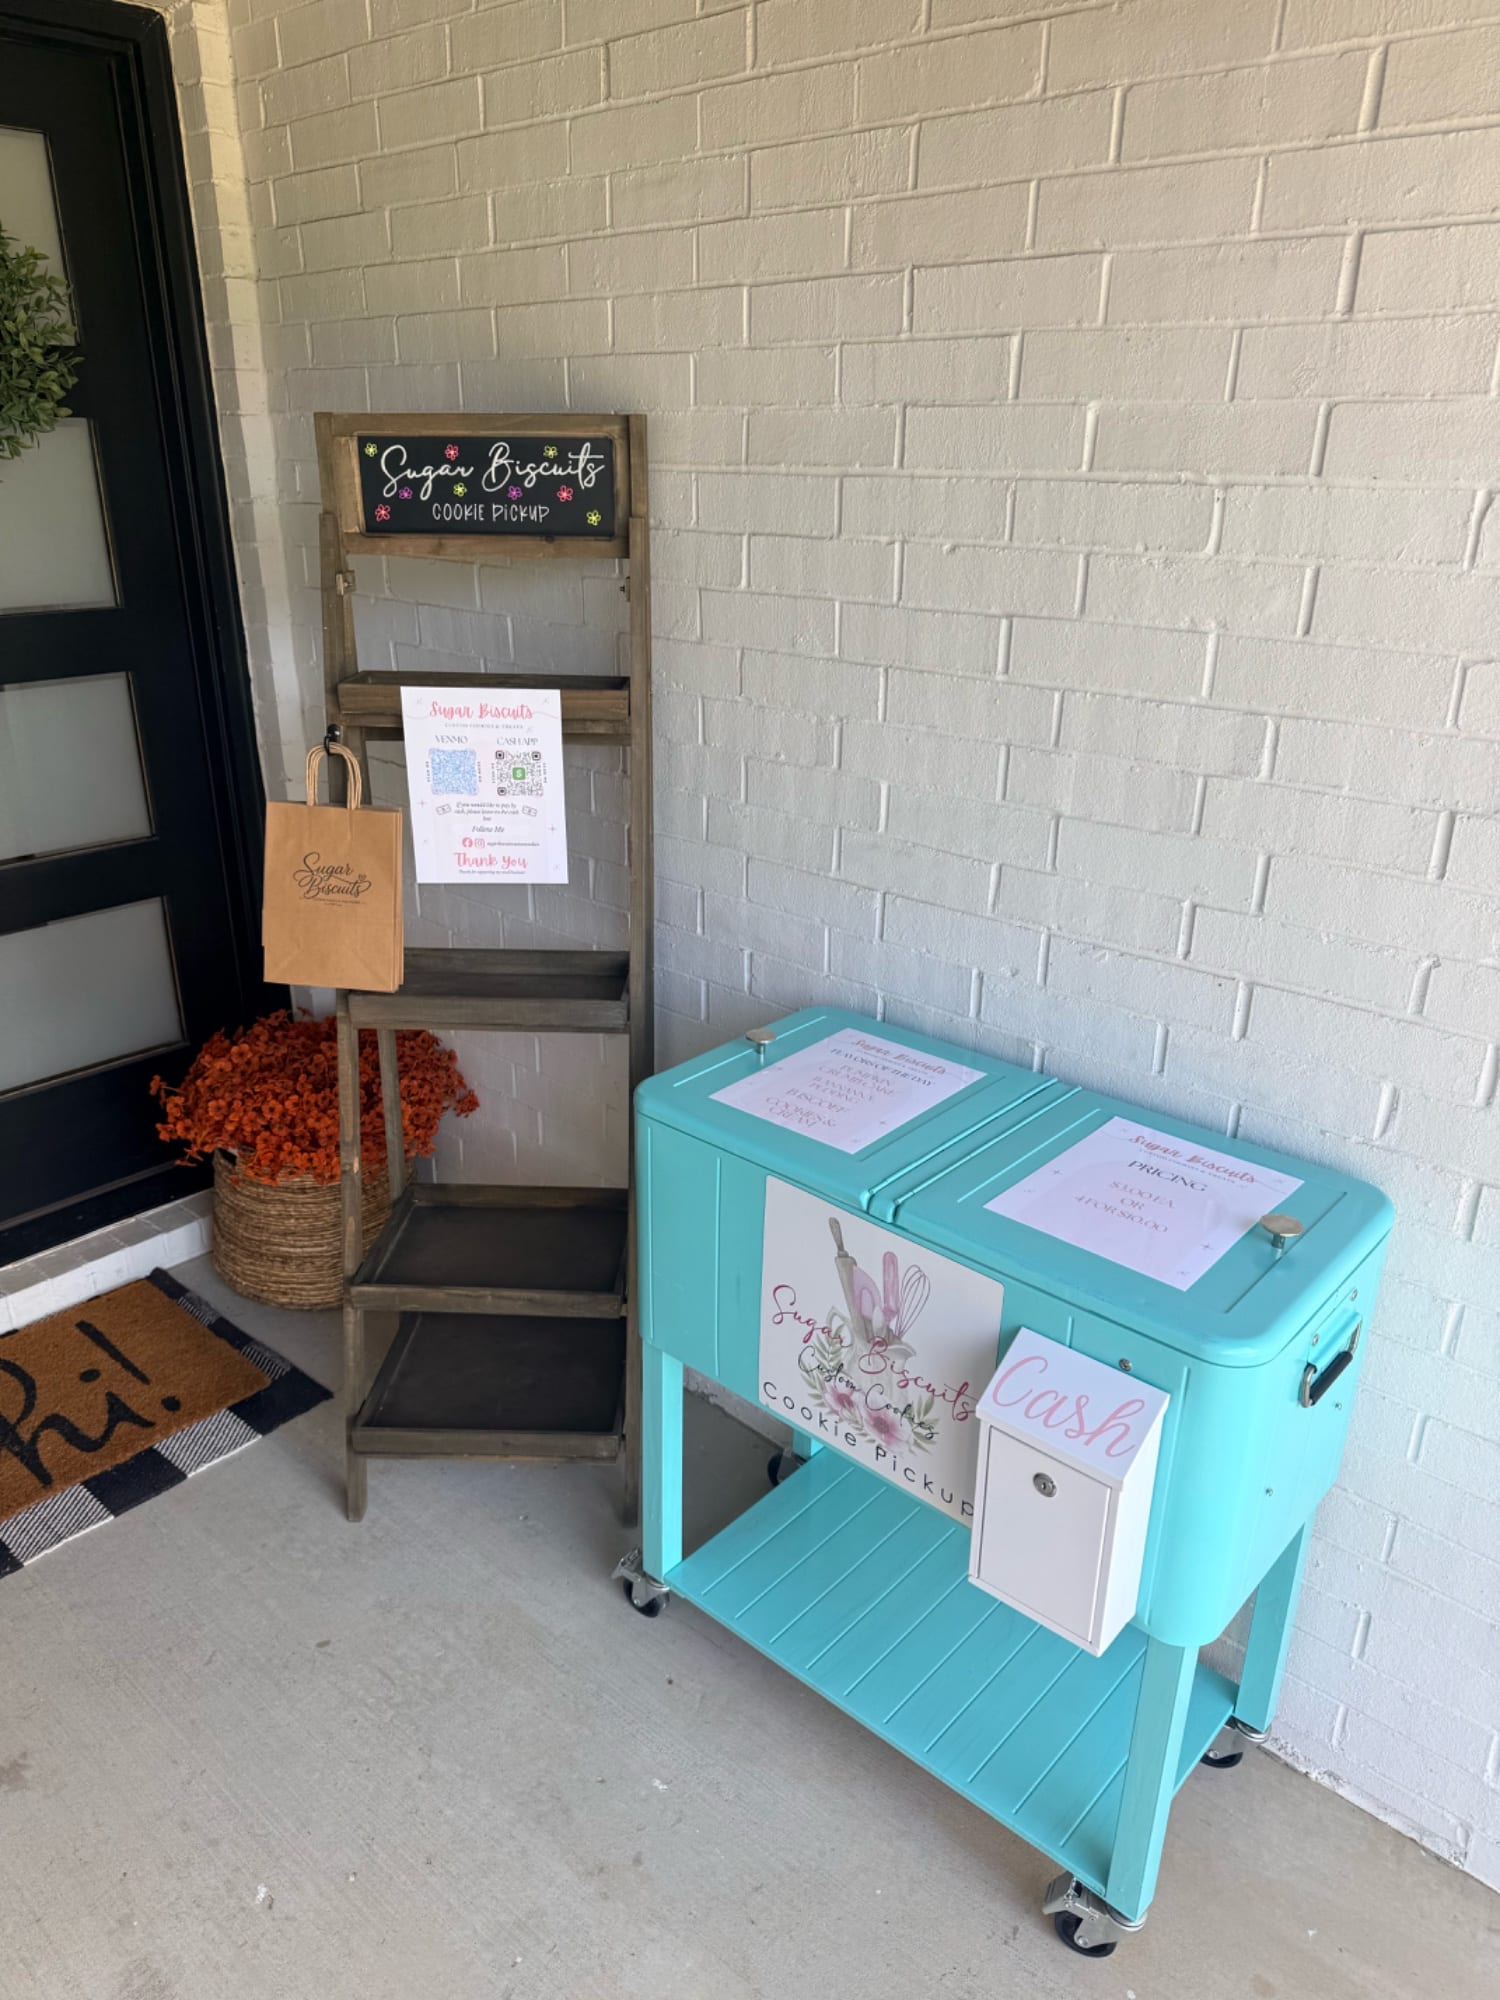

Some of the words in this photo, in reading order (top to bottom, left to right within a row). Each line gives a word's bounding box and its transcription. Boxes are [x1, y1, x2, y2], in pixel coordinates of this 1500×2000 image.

[380, 444, 474, 500] Sugar
[481, 442, 605, 492] Biscuits
[432, 503, 484, 521] COOKIE
[429, 700, 474, 720] Sugar
[478, 702, 534, 720] Biscuits
[434, 735, 468, 744] VENMO
[297, 851, 354, 882] Sugar
[453, 852, 497, 867] Thank
[298, 874, 366, 899] Biscuits
[894, 1053, 947, 1074] Biscuits
[1128, 1135, 1182, 1158] Sugar
[1185, 1155, 1255, 1183] Biscuits
[1128, 1160, 1208, 1191] PRICING
[1120, 1198, 1145, 1210] OR
[772, 1284, 851, 1348] Sugar
[858, 1336, 978, 1421] Biscuits
[798, 1345, 863, 1393] Custom
[865, 1383, 939, 1439] Cookies
[992, 1355, 1145, 1458] Cash
